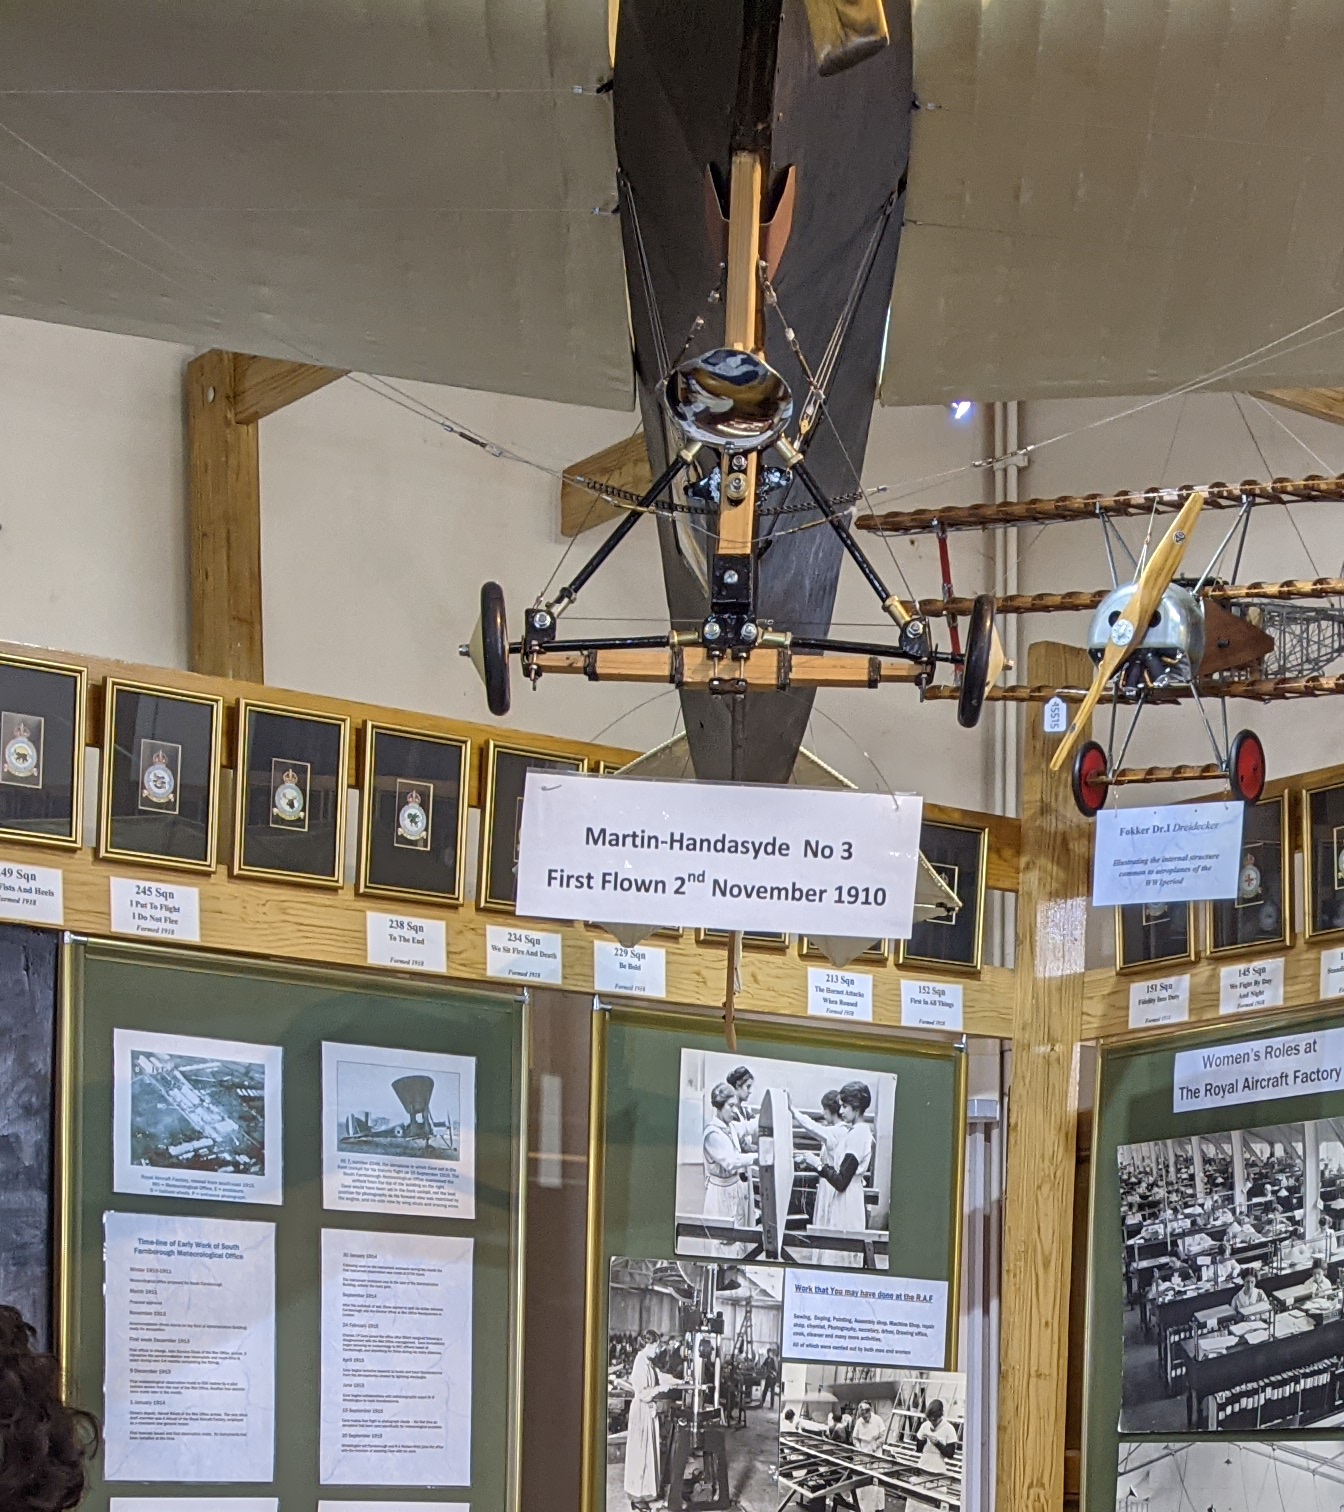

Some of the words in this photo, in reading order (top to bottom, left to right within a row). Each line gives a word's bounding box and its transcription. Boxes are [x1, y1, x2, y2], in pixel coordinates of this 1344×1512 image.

[1050, 702, 1060, 729] 45515
[1119, 826, 1149, 836] Fokker
[1151, 824, 1170, 834] Dr.I
[1172, 821, 1220, 832] Dreidecker
[585, 826, 789, 860] Martin-Handasyde
[803, 838, 833, 859] No
[841, 840, 853, 860] 3
[15, 869, 37, 883] Sqn
[17, 885, 32, 894] And
[34, 887, 54, 897] Heels
[135, 886, 152, 897] 245
[154, 888, 175, 901] Sqn
[547, 869, 594, 890] First
[601, 871, 667, 894] Flown
[673, 869, 705, 895] 2nd
[712, 877, 827, 902] November
[834, 884, 887, 905] 1910
[134, 901, 147, 909] Put
[149, 902, 158, 911] To
[159, 904, 180, 914] Flight
[137, 913, 147, 921] Do
[149, 914, 162, 923] Not
[163, 916, 178, 925] Flee
[389, 920, 404, 930] 238
[406, 922, 424, 934] Sqn
[388, 934, 396, 942] To
[398, 935, 410, 943] The
[411, 937, 425, 945] End
[507, 933, 522, 943] 234
[524, 935, 541, 946] Sqn
[614, 948, 628, 958] 229
[630, 950, 646, 961] Sqn
[826, 974, 838, 984] 213
[840, 976, 855, 987] Sqn
[918, 986, 930, 995] 152
[931, 987, 946, 998] Sqn
[1203, 1050, 1260, 1069] Women's
[1263, 1044, 1300, 1061] Roles
[1303, 1040, 1317, 1056] at
[1179, 1085, 1200, 1101] The
[1203, 1079, 1238, 1099] Royal
[1241, 1072, 1289, 1092] Aircraft
[1292, 1068, 1341, 1085] Factory
